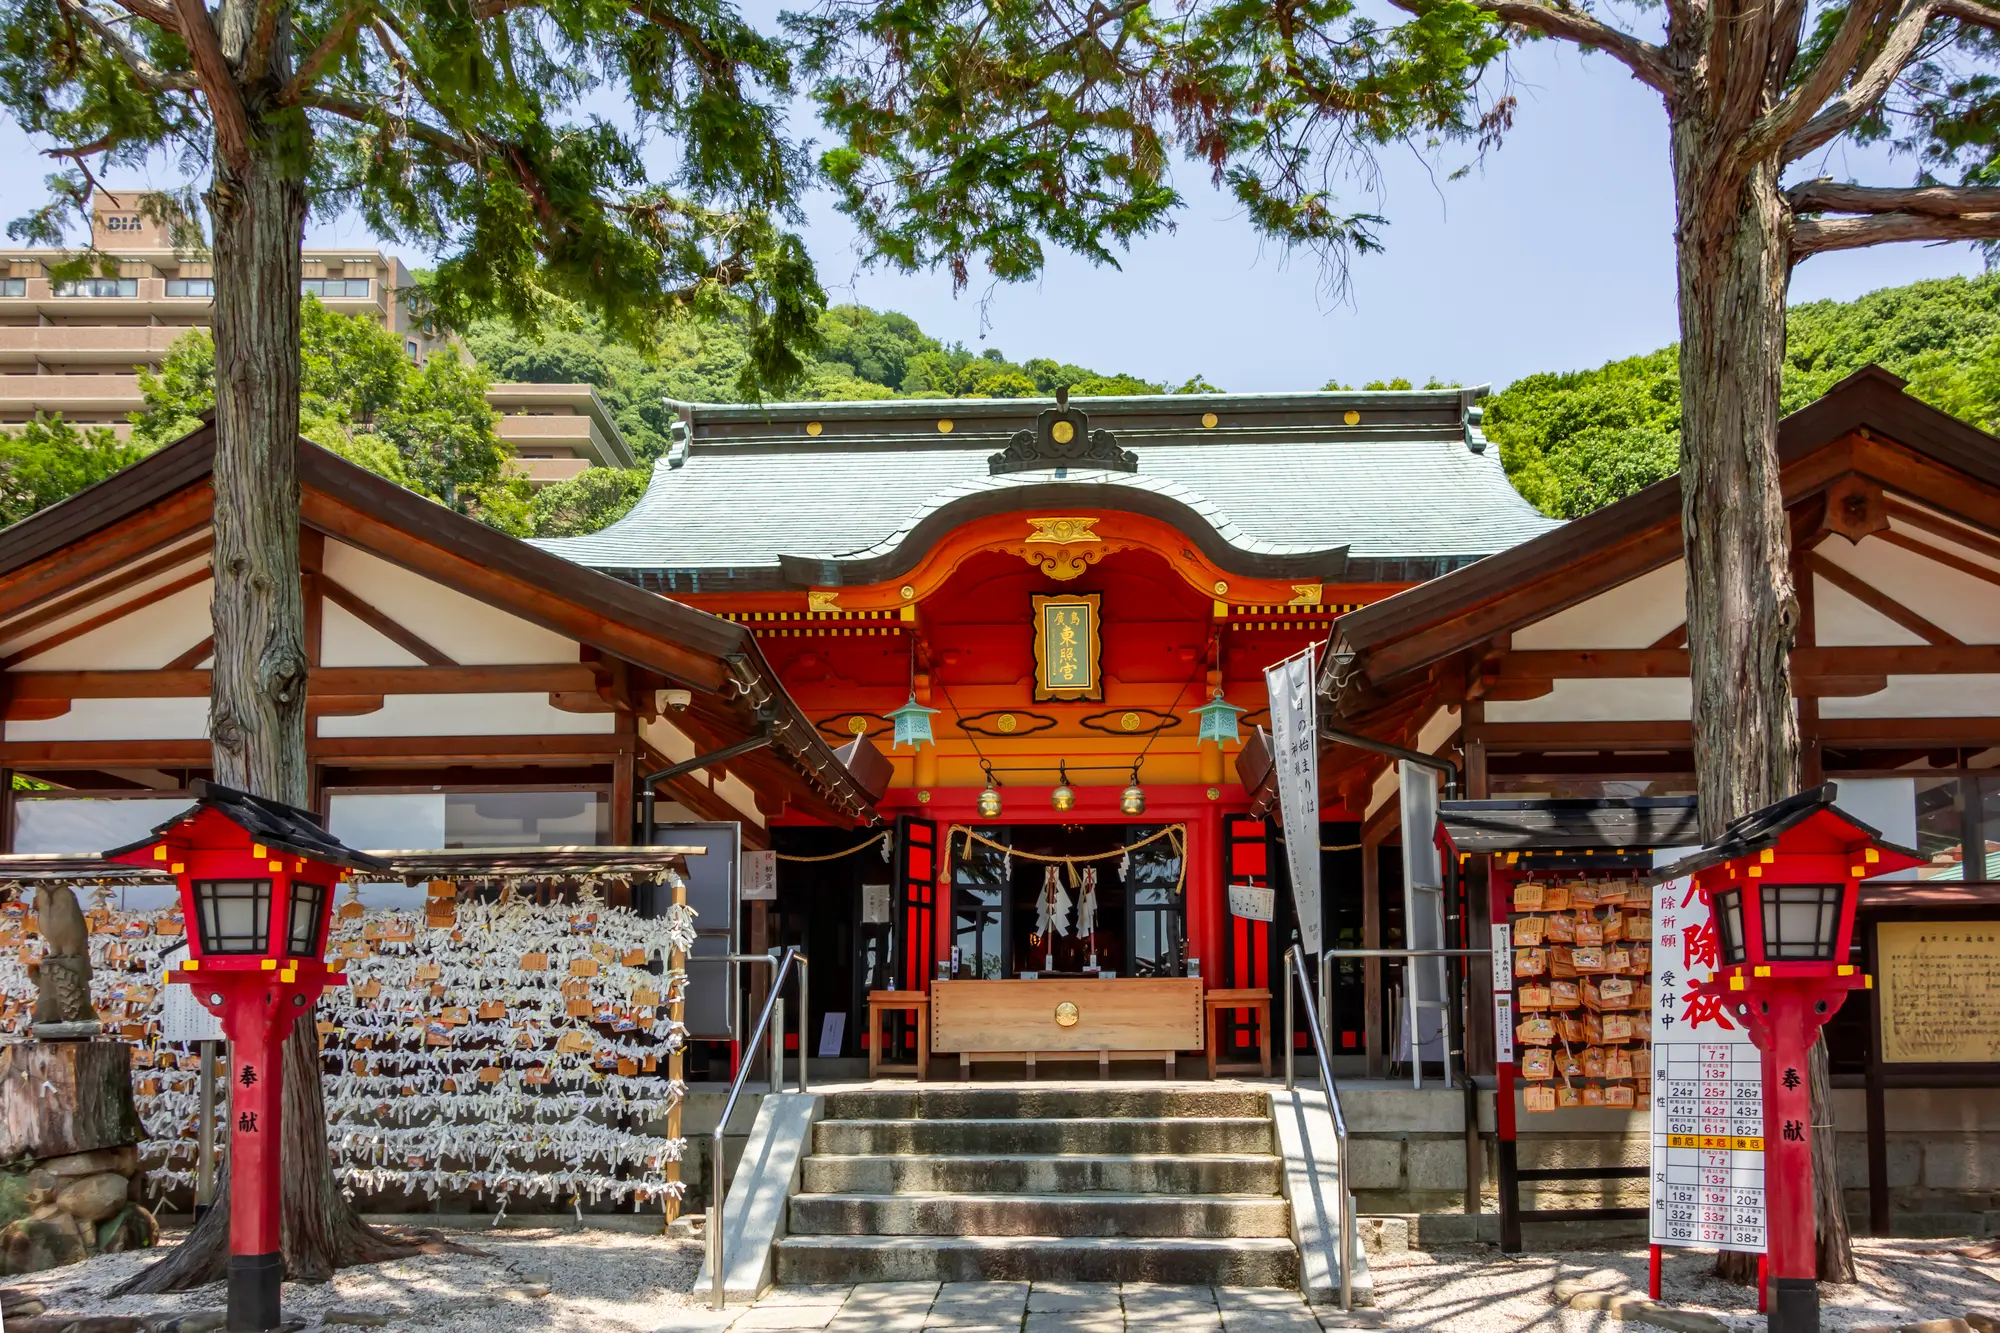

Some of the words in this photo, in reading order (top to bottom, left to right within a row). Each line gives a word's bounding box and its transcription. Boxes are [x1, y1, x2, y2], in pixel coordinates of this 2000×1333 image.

[109, 216, 142, 230] DIA
[1059, 625, 1078, 681] 東照宮
[1296, 681, 1315, 814] 一日の始まりは
[1660, 970, 1676, 1031] 受付中
[1709, 1050, 1725, 1060] 7才
[1705, 1069, 1726, 1078] 13才
[1657, 1070, 1666, 1108] 男性
[1672, 1088, 1693, 1097] 24才
[1704, 1088, 1726, 1097] 25才
[1736, 1089, 1758, 1098] 26才
[239, 1065, 259, 1133] 奉献
[1781, 1068, 1806, 1142] 奉献
[1672, 1106, 1693, 1115] 41才
[1704, 1106, 1726, 1115] 42才
[1736, 1107, 1758, 1116] 43才
[1672, 1124, 1693, 1133] 60才
[1704, 1125, 1726, 1134] 61才
[1736, 1126, 1758, 1135] 62才
[1673, 1137, 1694, 1146] 前厄
[1704, 1138, 1726, 1147] 本厄
[1737, 1140, 1760, 1148] 後厄
[1709, 1156, 1725, 1166] 7才
[1705, 1175, 1726, 1184] 13才
[1656, 1172, 1665, 1210] 女性
[1672, 1192, 1693, 1201] 18才
[1704, 1193, 1726, 1203] 19才
[1736, 1196, 1758, 1205] 20才
[1672, 1210, 1693, 1220] 32才
[1704, 1212, 1726, 1222] 33才
[1736, 1215, 1758, 1224] 34才
[1672, 1228, 1693, 1238] 36才
[1704, 1230, 1726, 1240] 37才
[1736, 1233, 1758, 1243] 38才
